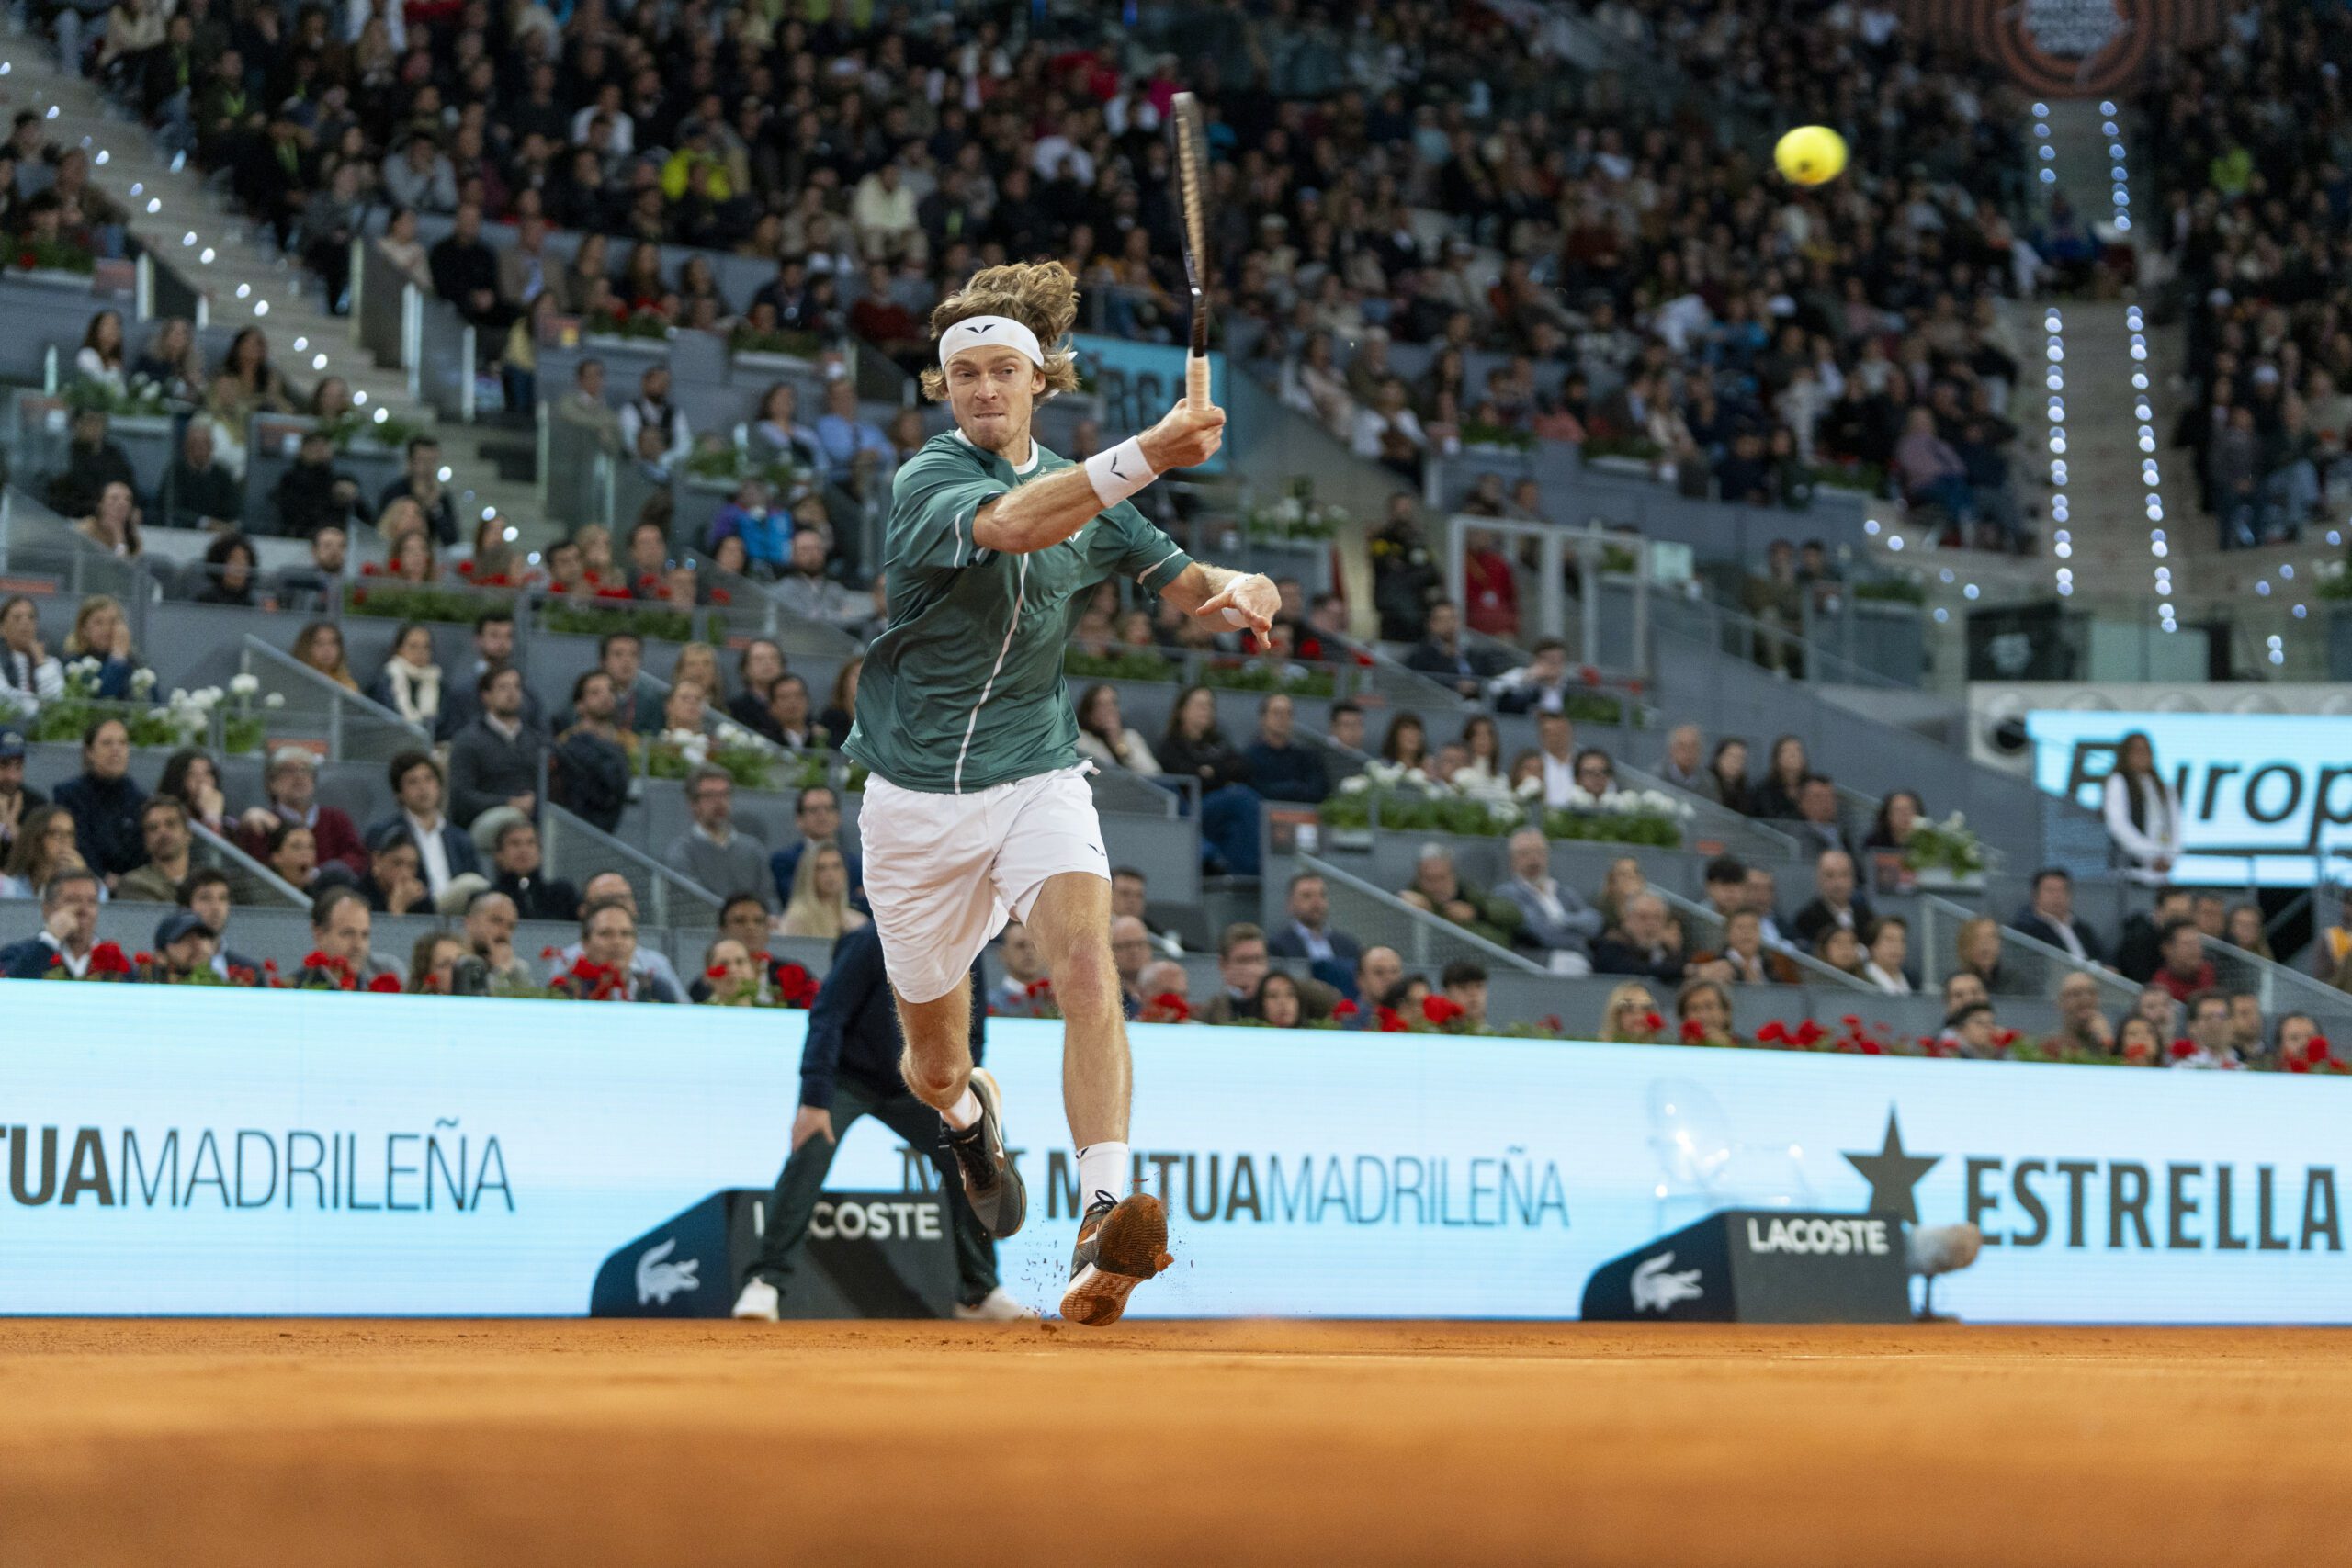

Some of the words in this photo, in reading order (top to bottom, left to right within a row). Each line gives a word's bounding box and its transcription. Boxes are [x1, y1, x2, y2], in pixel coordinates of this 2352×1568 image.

[2068, 740, 2352, 853] Erop
[0, 1118, 514, 1211] UAMADRILEÑA
[1047, 1145, 1570, 1226] MTUAMADRILEÑA
[1965, 1158, 2343, 1251] ESTRELLA
[753, 1201, 943, 1240] LCOSTE
[1747, 1217, 1890, 1255] LACOSTE
